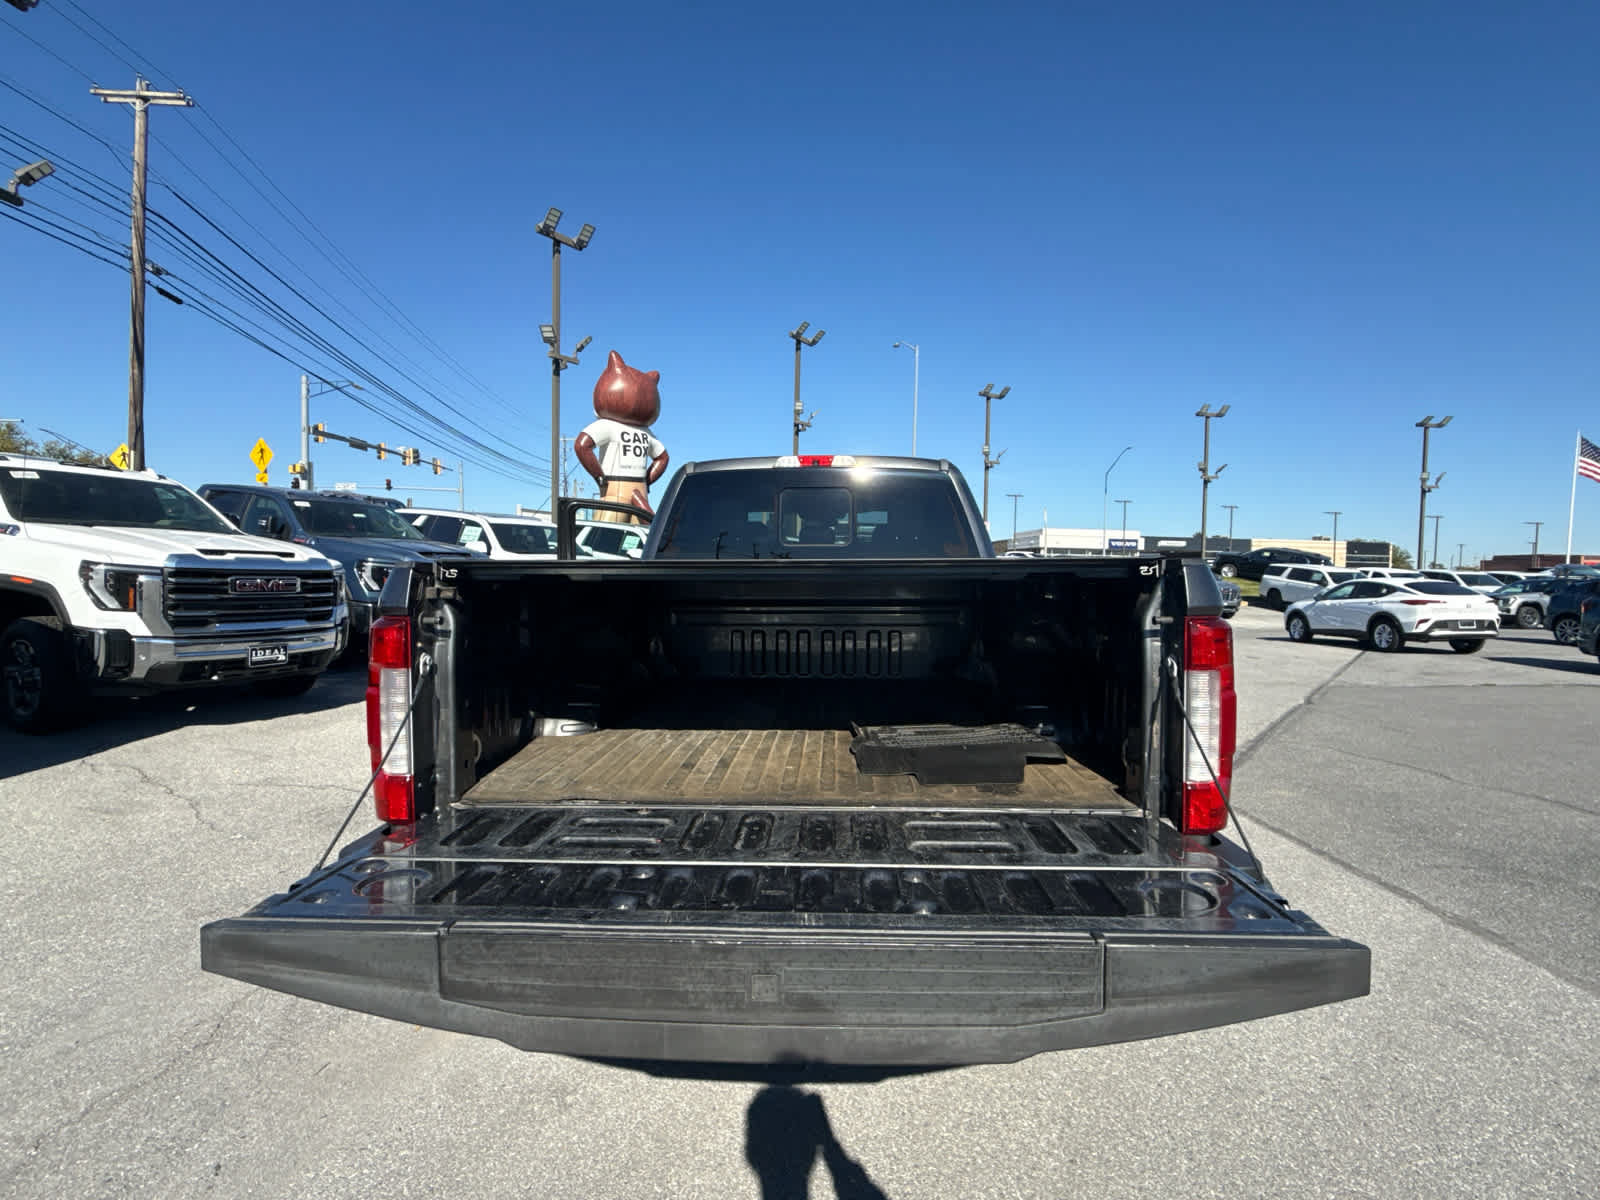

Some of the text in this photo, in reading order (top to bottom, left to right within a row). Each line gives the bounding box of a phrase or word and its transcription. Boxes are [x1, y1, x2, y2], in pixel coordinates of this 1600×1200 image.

[620, 431, 649, 444] CAR
[622, 444, 649, 457] FOX
[236, 579, 298, 592] GMC
[252, 648, 286, 657] IDEAL
